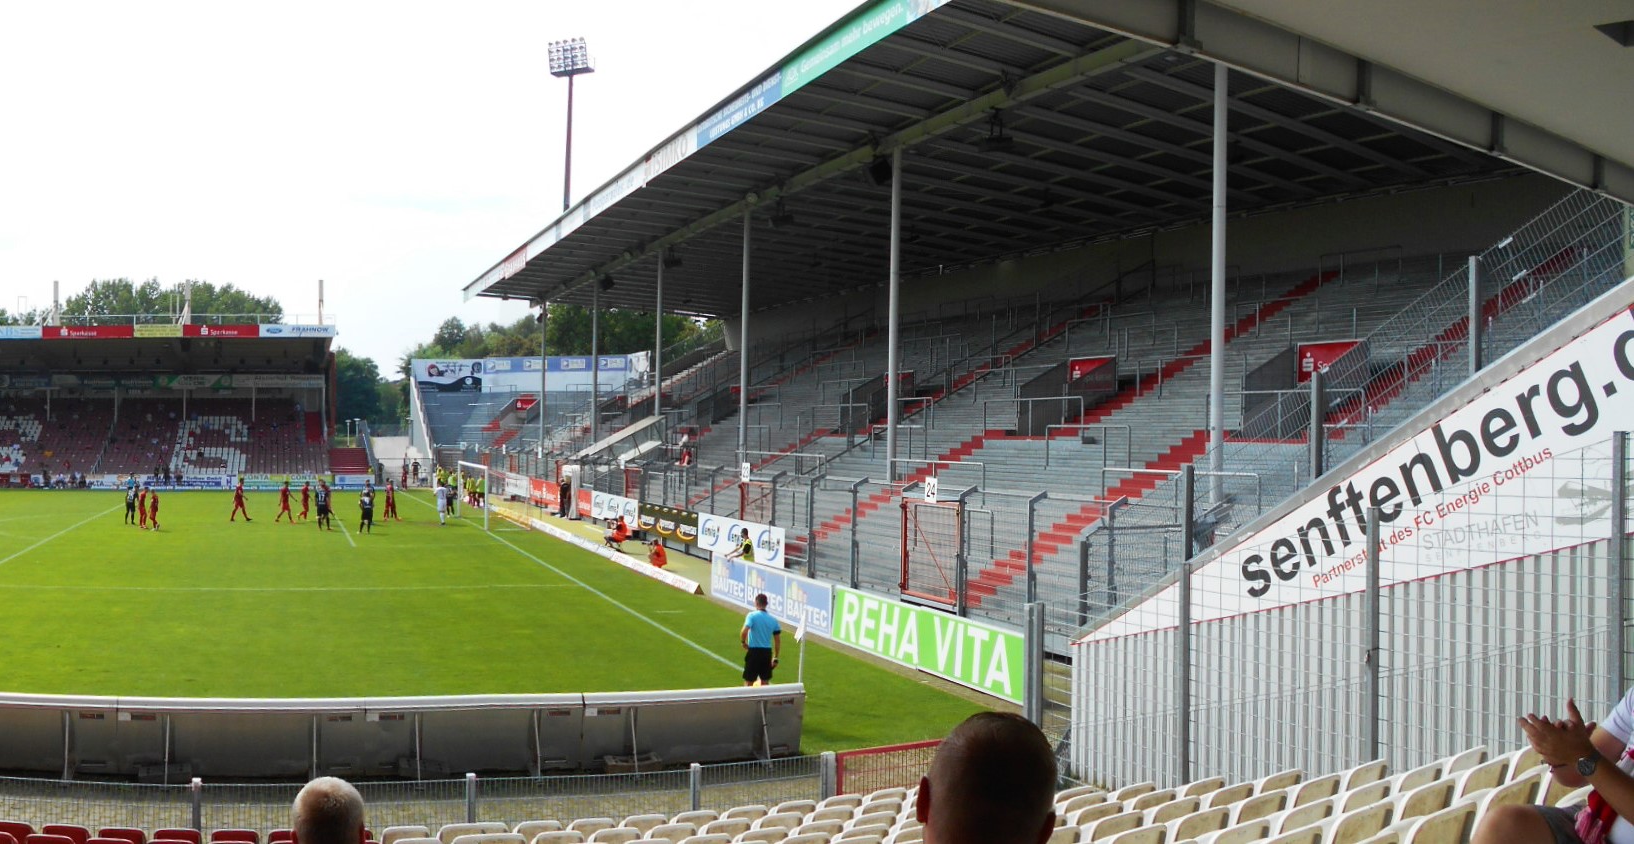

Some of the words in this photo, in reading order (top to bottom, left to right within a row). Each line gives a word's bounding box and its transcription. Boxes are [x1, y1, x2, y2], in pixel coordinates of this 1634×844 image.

[800, 42, 841, 73] Gemeinsam
[841, 27, 862, 50] mehr
[862, 2, 904, 34] bewegen.
[292, 327, 329, 335] FRAHNOW
[926, 481, 936, 498] 24
[1312, 537, 1387, 589] Partnerstt
[1389, 526, 1413, 546] des
[1413, 510, 1435, 532] FC
[1435, 483, 1491, 520] Energie
[1493, 447, 1553, 487] Cottbus
[1422, 510, 1539, 551] STADTHAFEN
[713, 575, 744, 597] BAUTEC
[747, 587, 783, 611] BATEC
[787, 596, 827, 628] BAUTEC
[840, 591, 919, 665] REHA
[933, 615, 1012, 696] VITA
